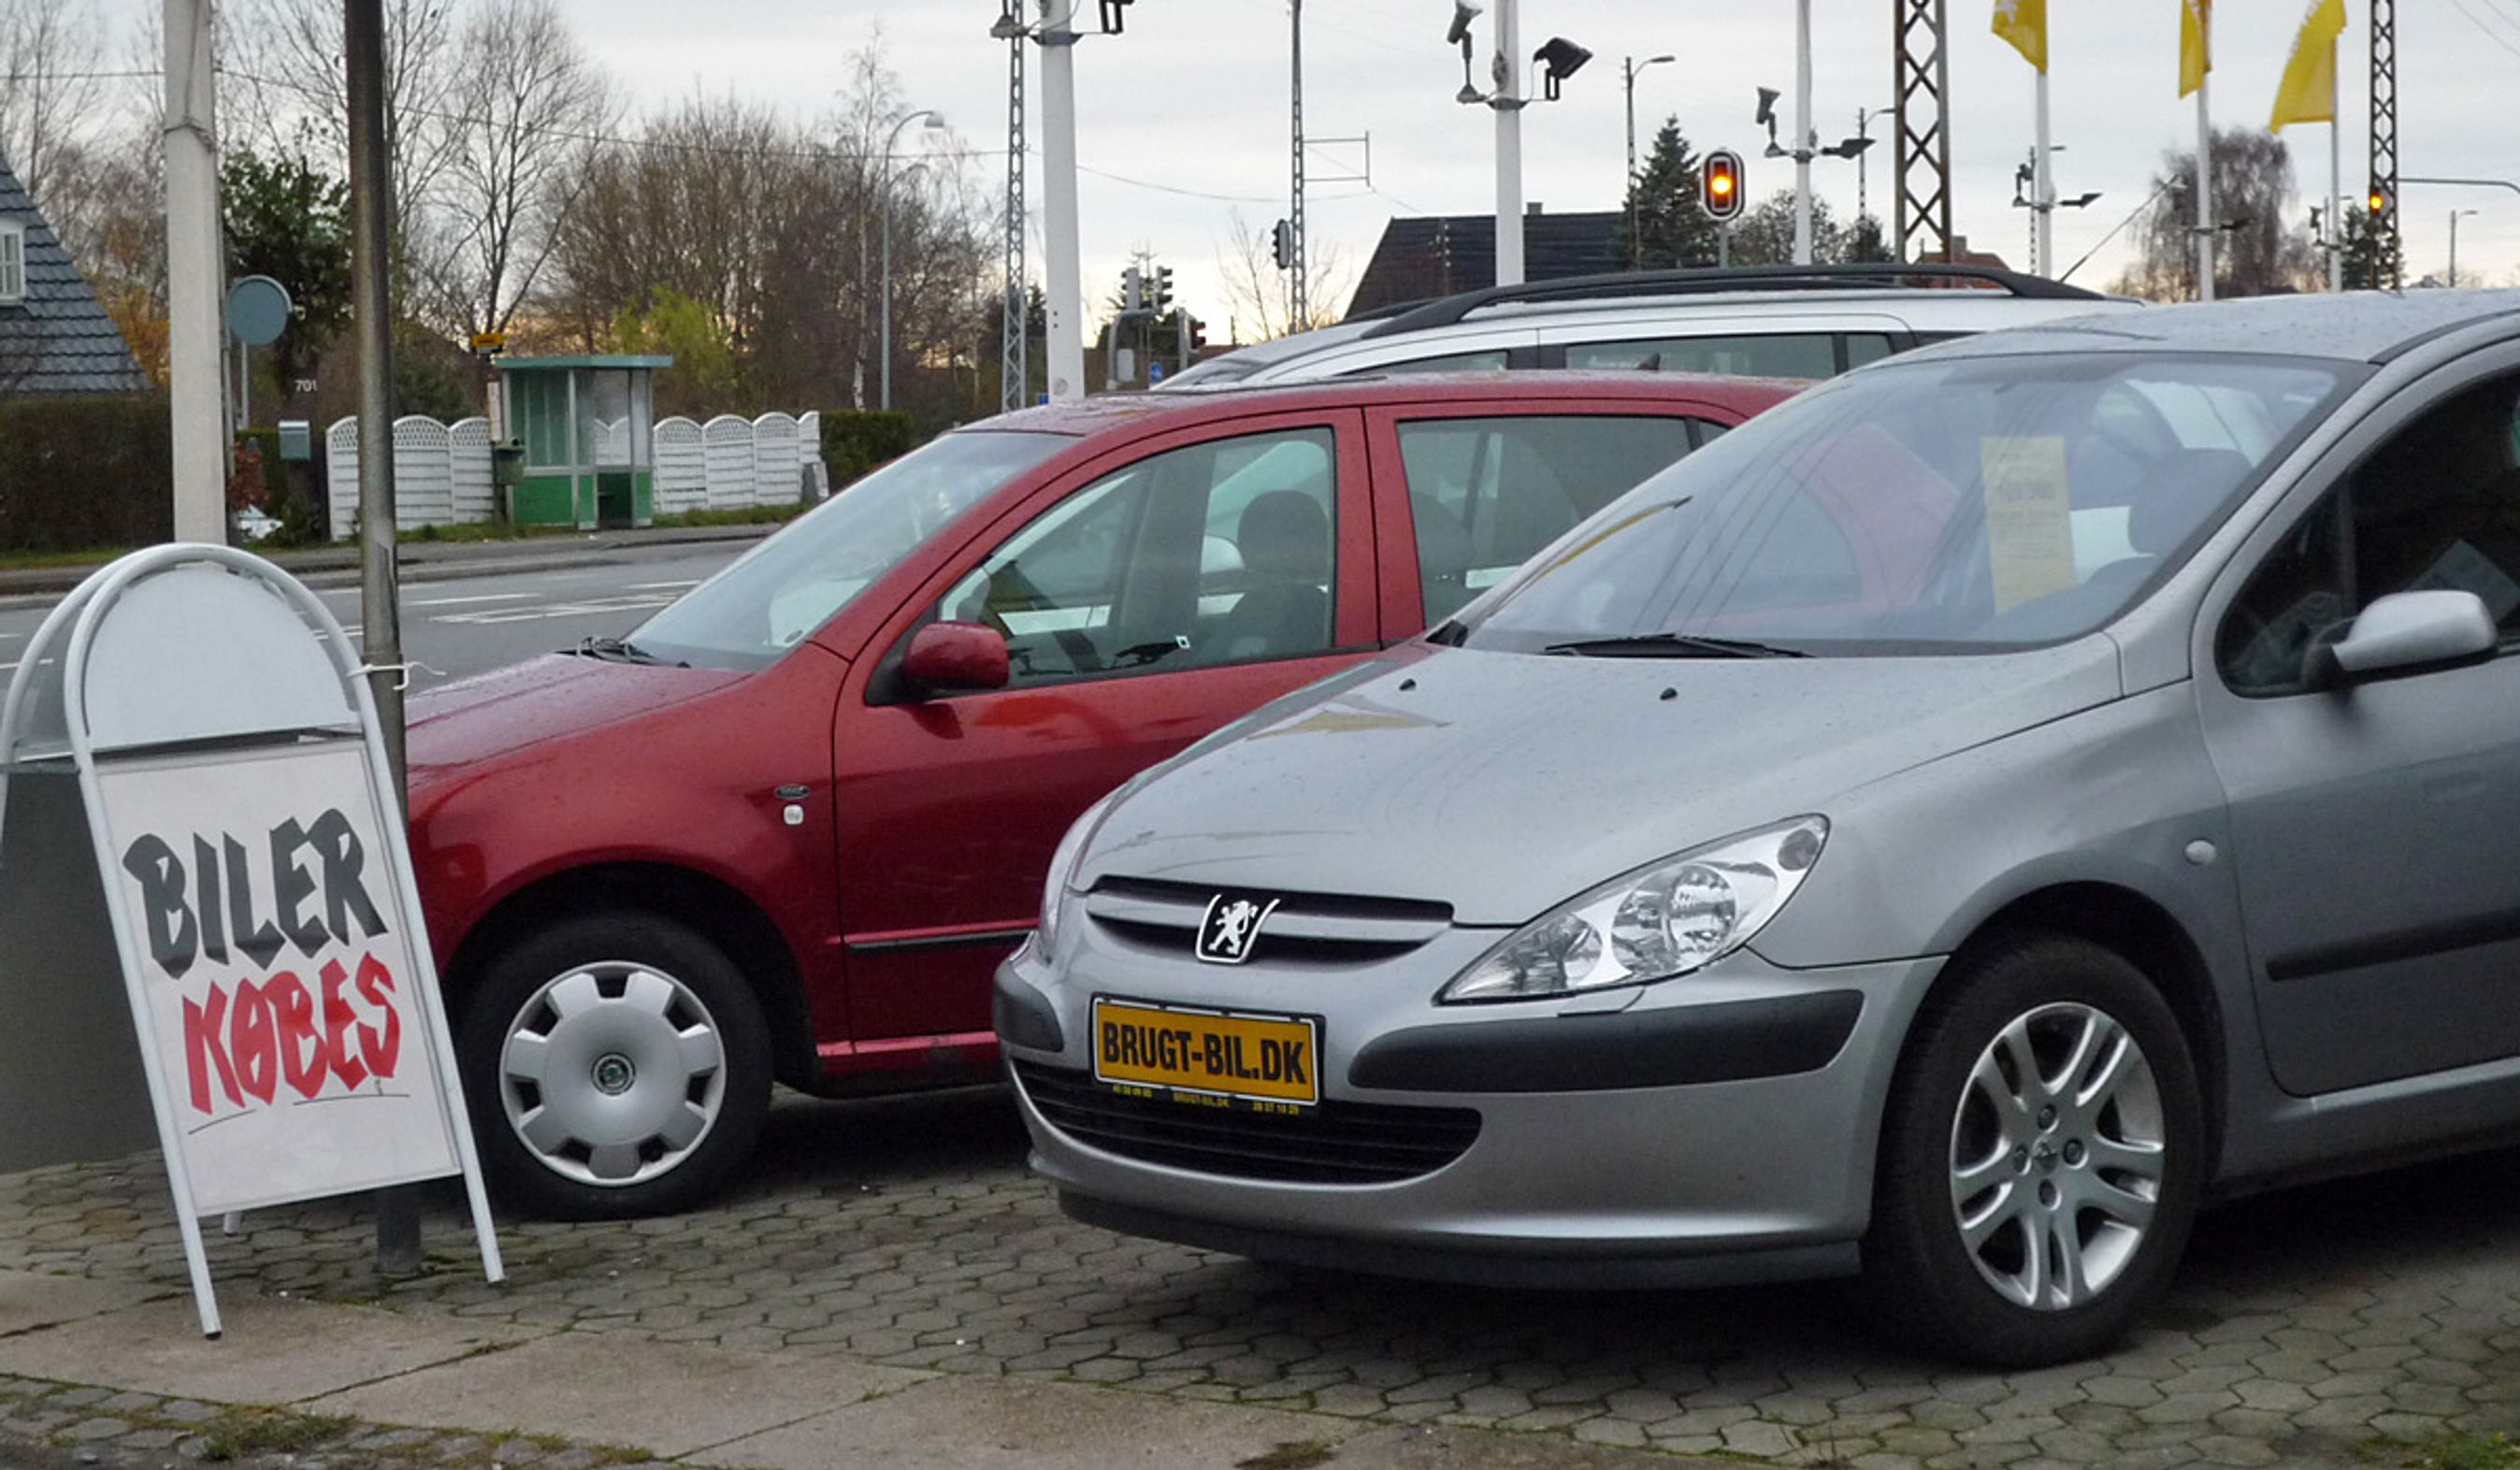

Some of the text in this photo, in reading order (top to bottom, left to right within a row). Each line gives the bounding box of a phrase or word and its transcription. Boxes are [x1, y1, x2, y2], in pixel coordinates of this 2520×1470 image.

[294, 379, 318, 392] 701
[122, 808, 389, 980] BILER
[181, 951, 401, 1116] KØBES
[1102, 1021, 1307, 1085] BRUGT-BIL.DK
